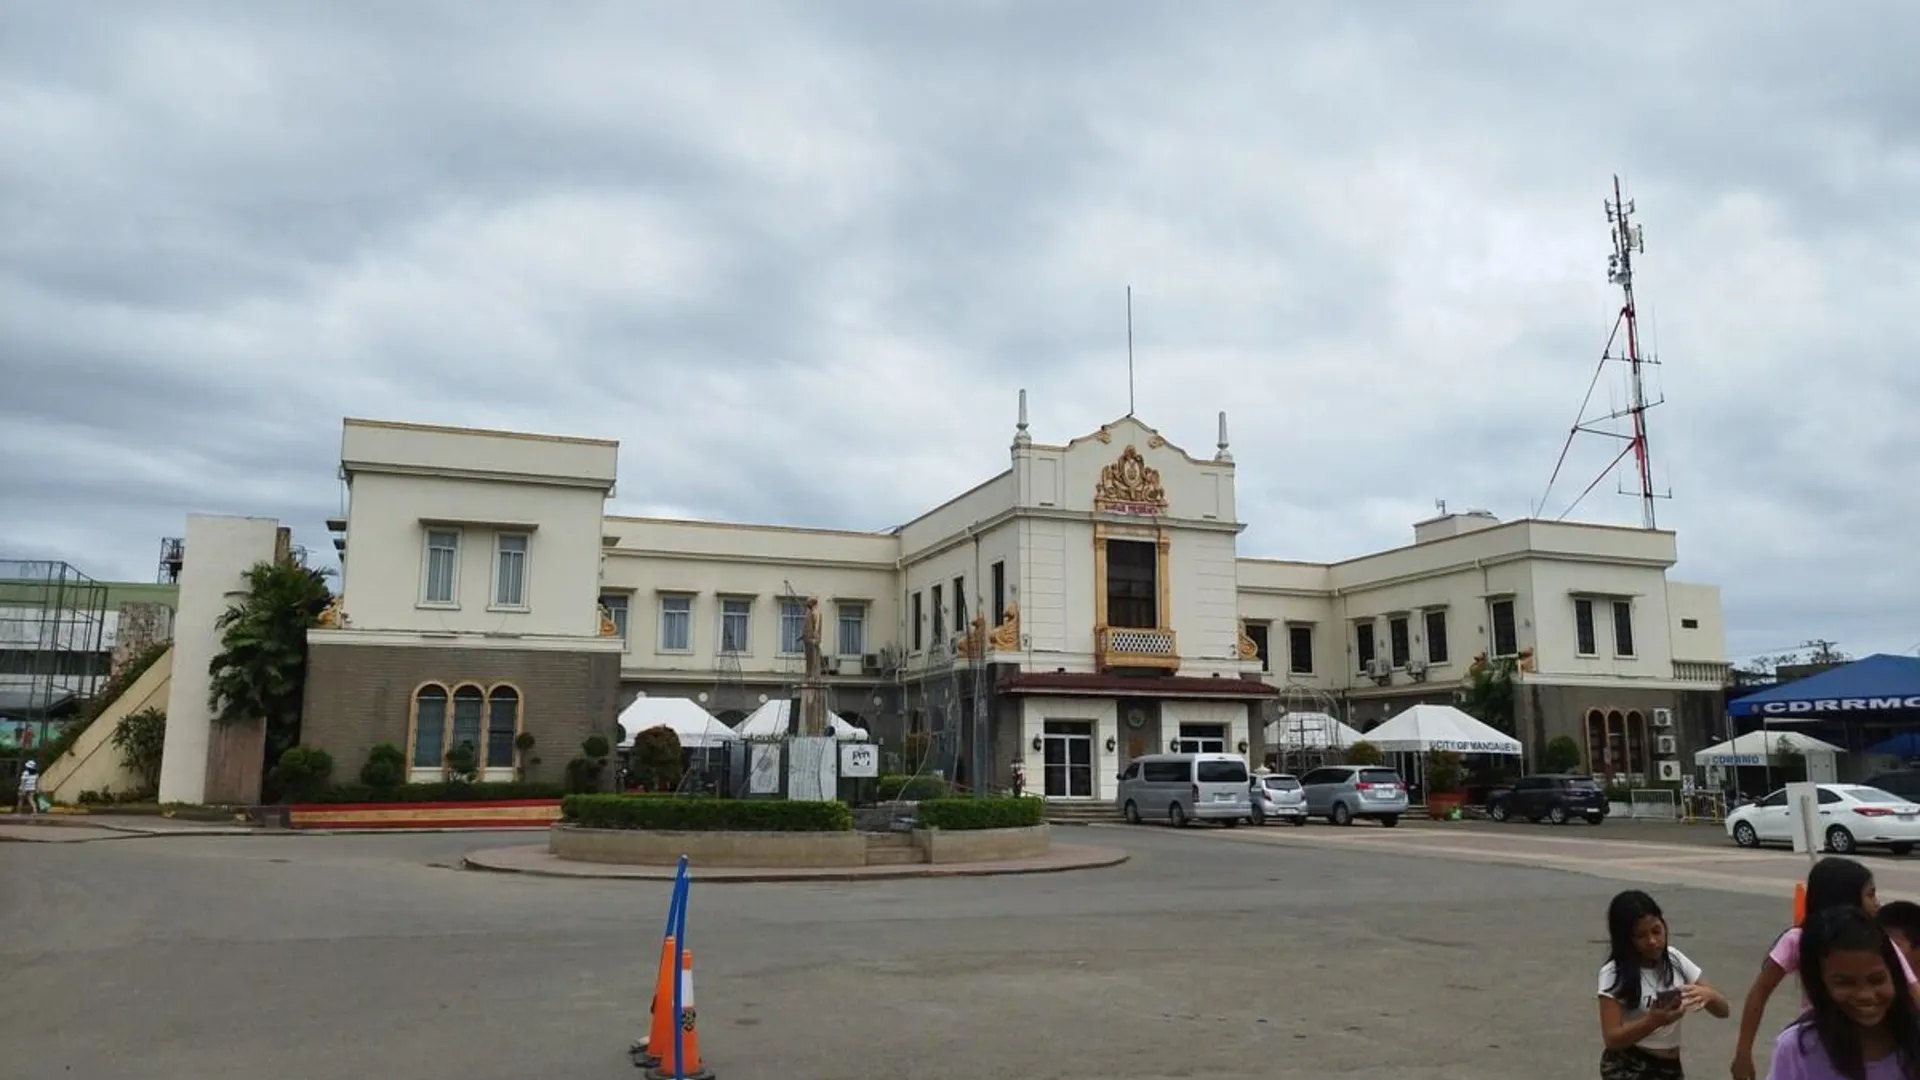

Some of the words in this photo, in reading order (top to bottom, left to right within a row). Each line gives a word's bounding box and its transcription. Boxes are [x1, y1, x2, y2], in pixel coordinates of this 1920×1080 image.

[1763, 696, 1920, 714] CDRRMO
[1436, 741, 1456, 750] CITY
[1457, 741, 1469, 750] OF
